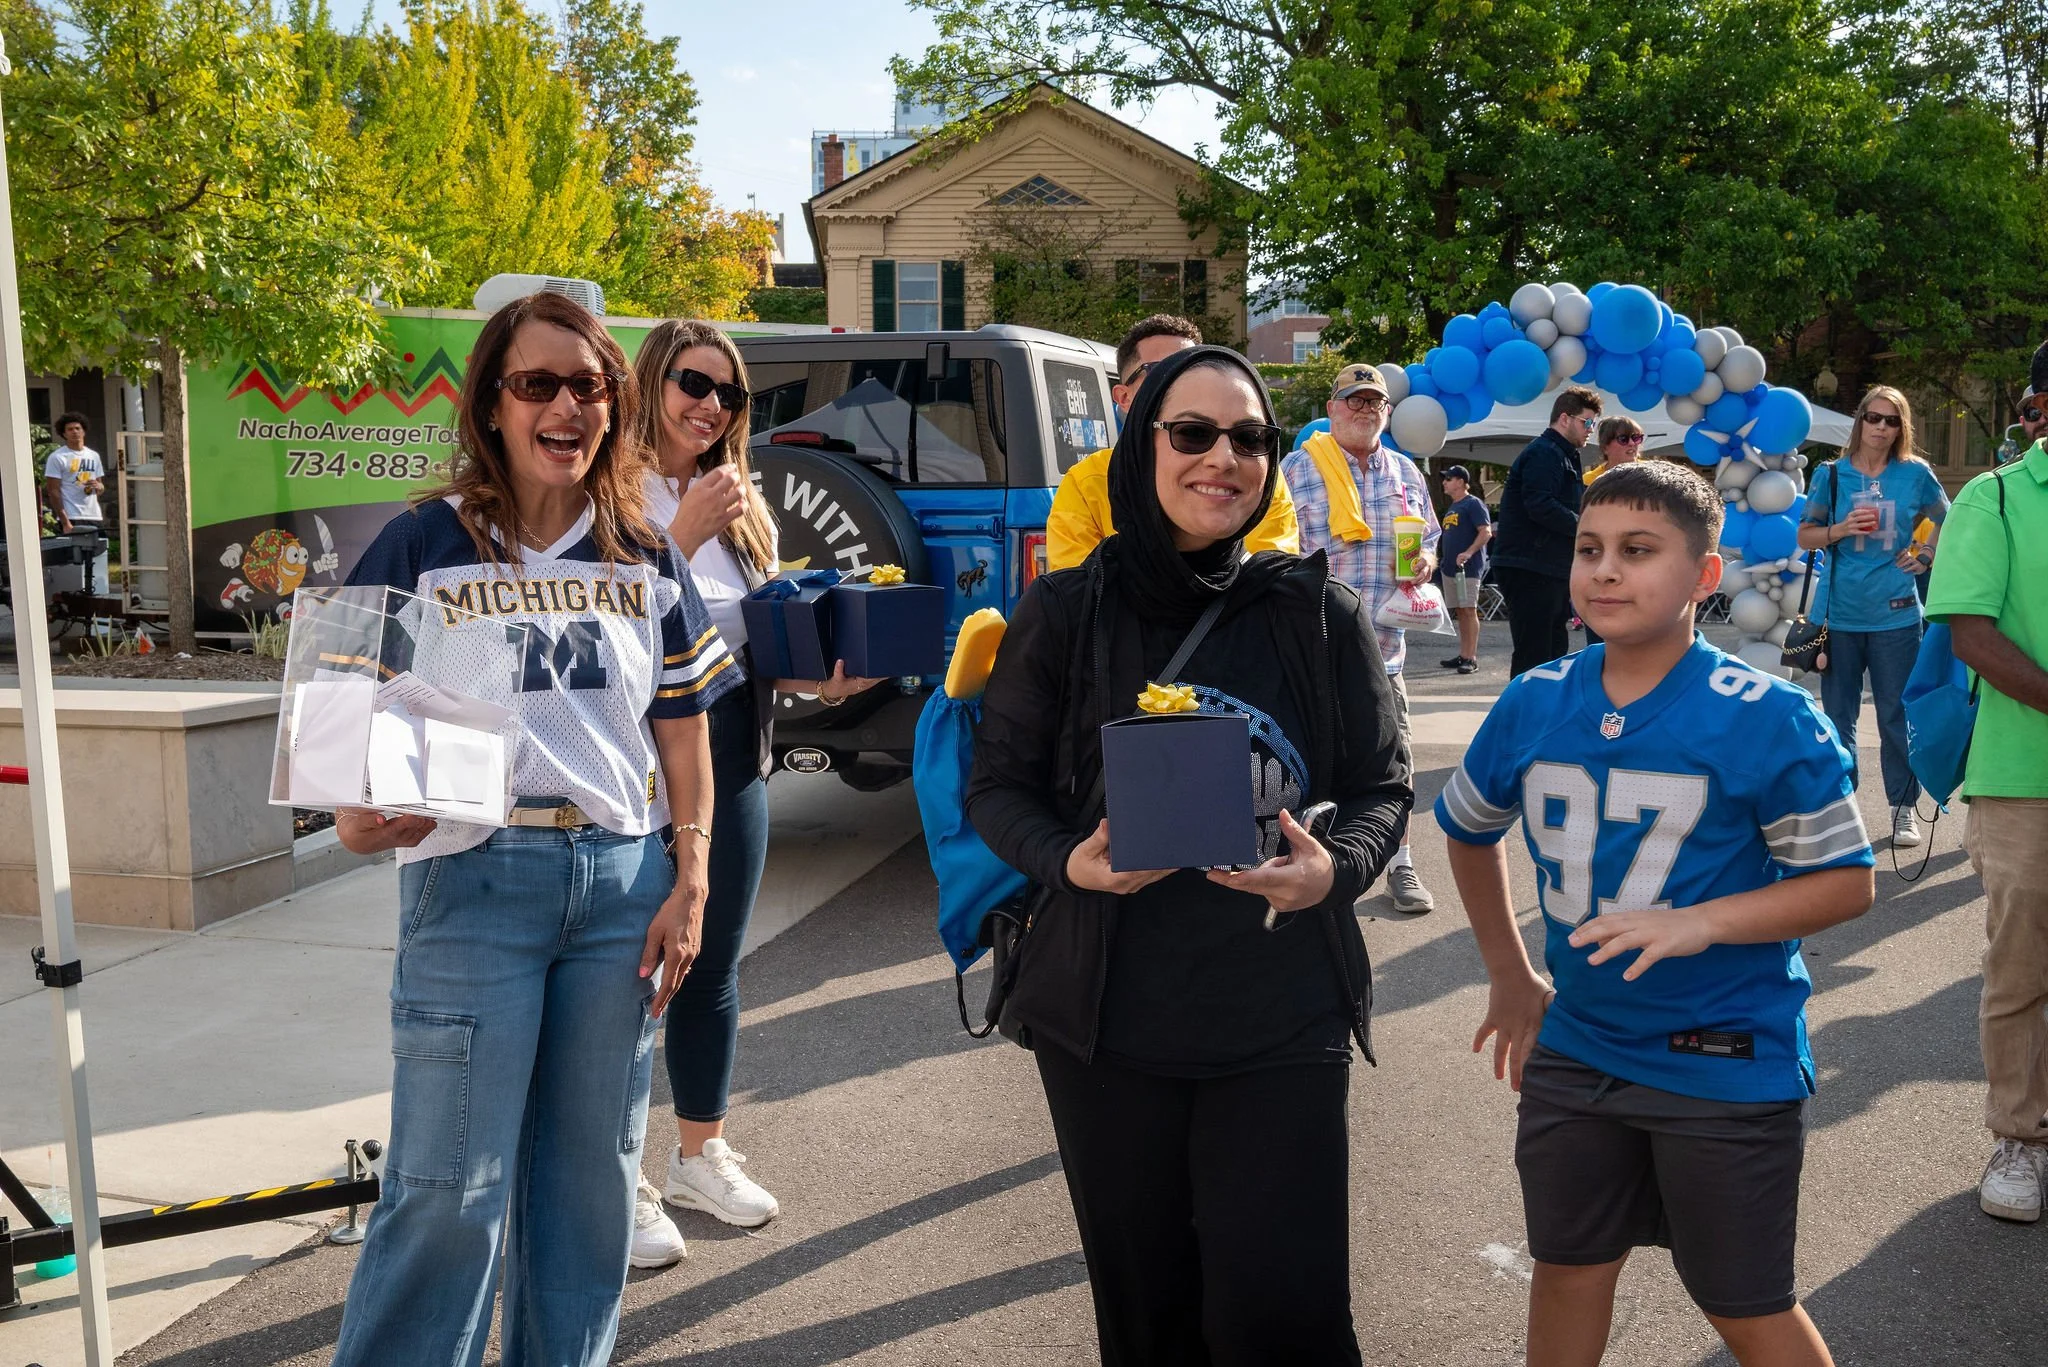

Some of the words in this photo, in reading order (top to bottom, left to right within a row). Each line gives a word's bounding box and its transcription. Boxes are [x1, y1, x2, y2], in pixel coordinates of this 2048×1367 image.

[1066, 390, 1088, 415] GRIT
[783, 472, 875, 578] WITH
[434, 578, 648, 627] MICHIGAN
[505, 620, 607, 693] M
[1603, 723, 1620, 735] NFL
[793, 752, 821, 763] VARSITY
[1521, 759, 1709, 927] 97
